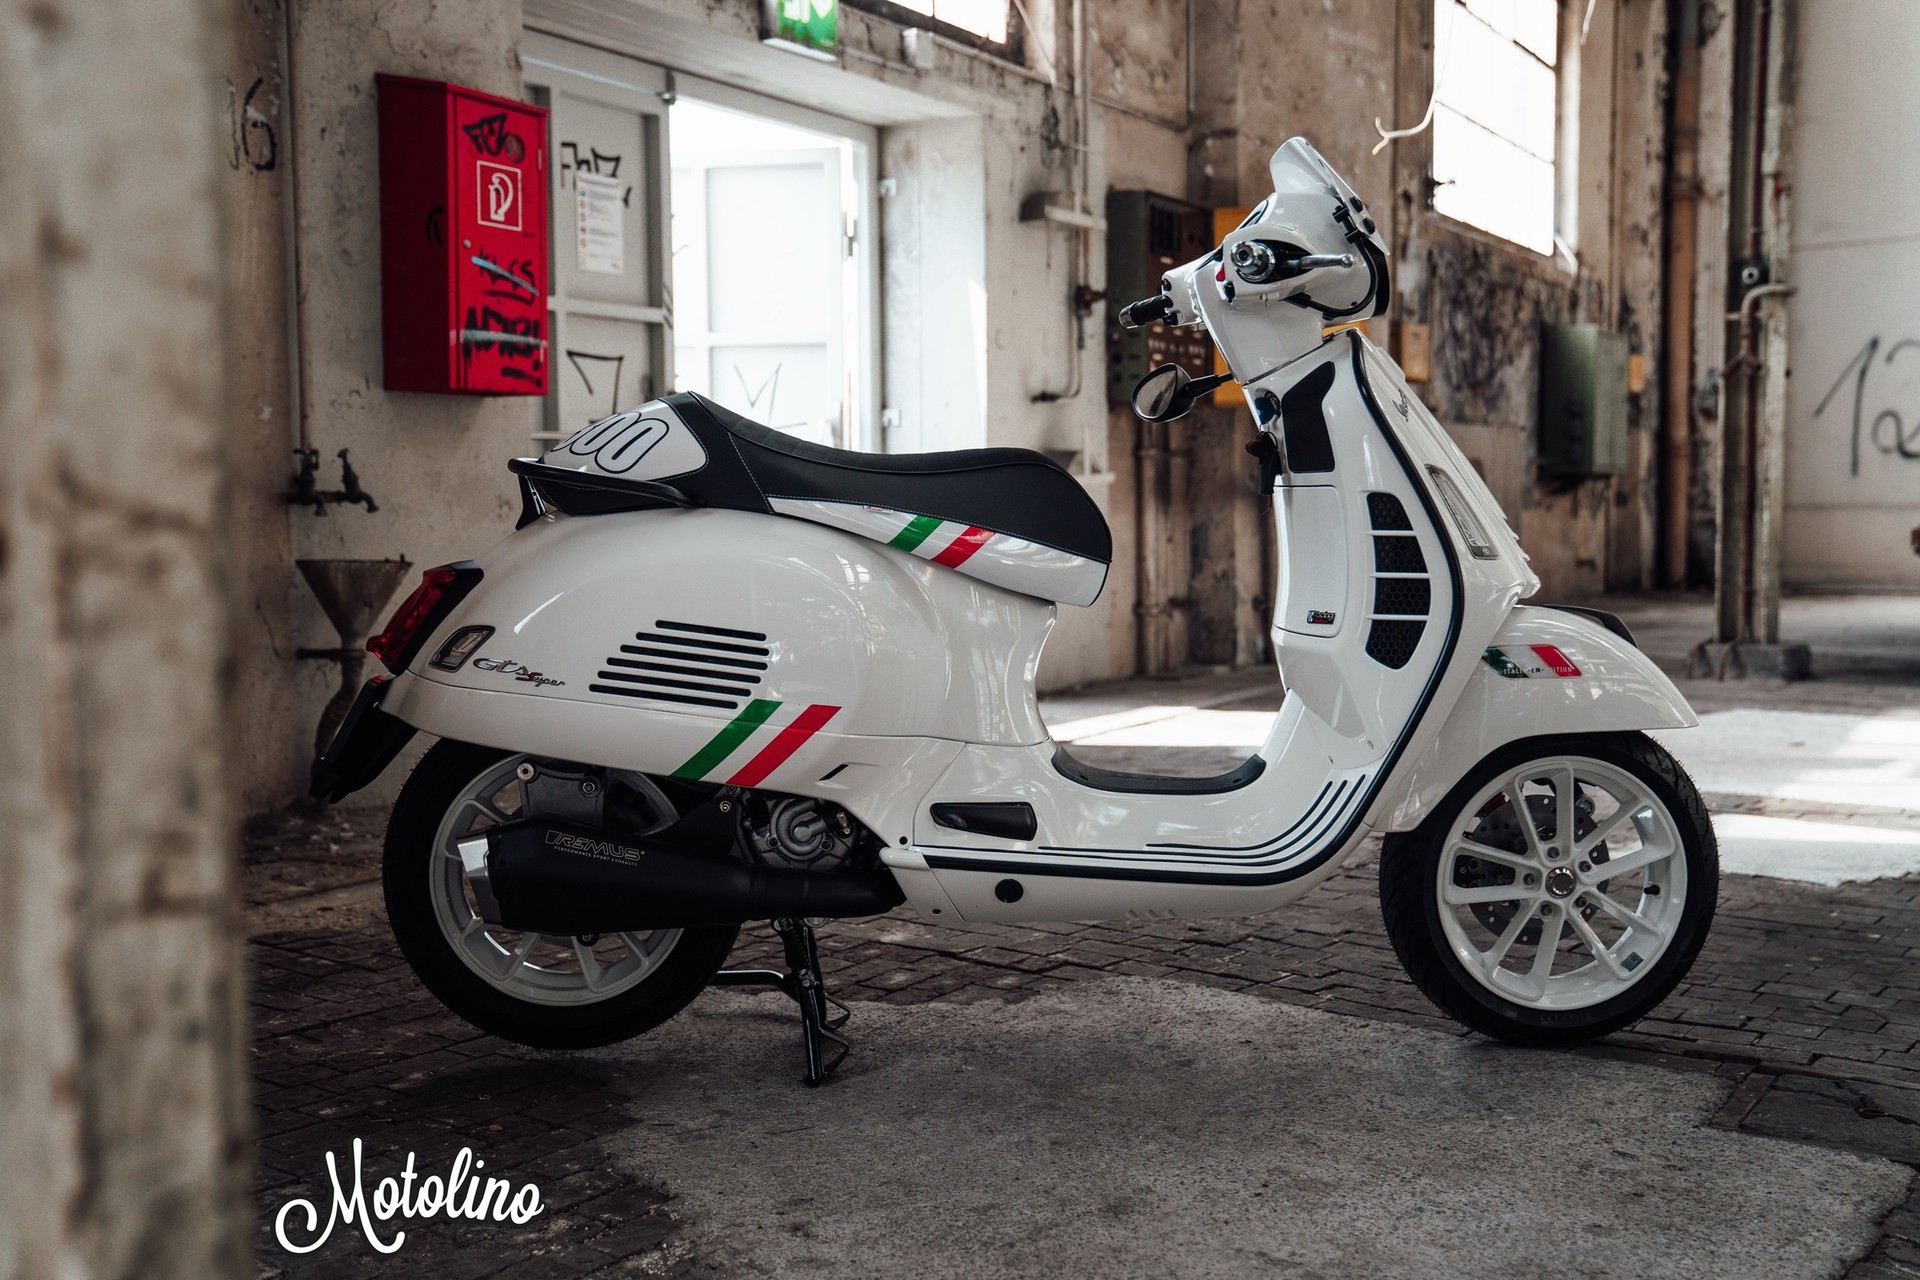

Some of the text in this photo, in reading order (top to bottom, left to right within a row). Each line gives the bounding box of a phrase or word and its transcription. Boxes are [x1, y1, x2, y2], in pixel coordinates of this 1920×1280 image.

[554, 846, 592, 857] PERFORMANCE
[611, 858, 638, 867] EXHAUSTS
[555, 833, 641, 861] REMUS
